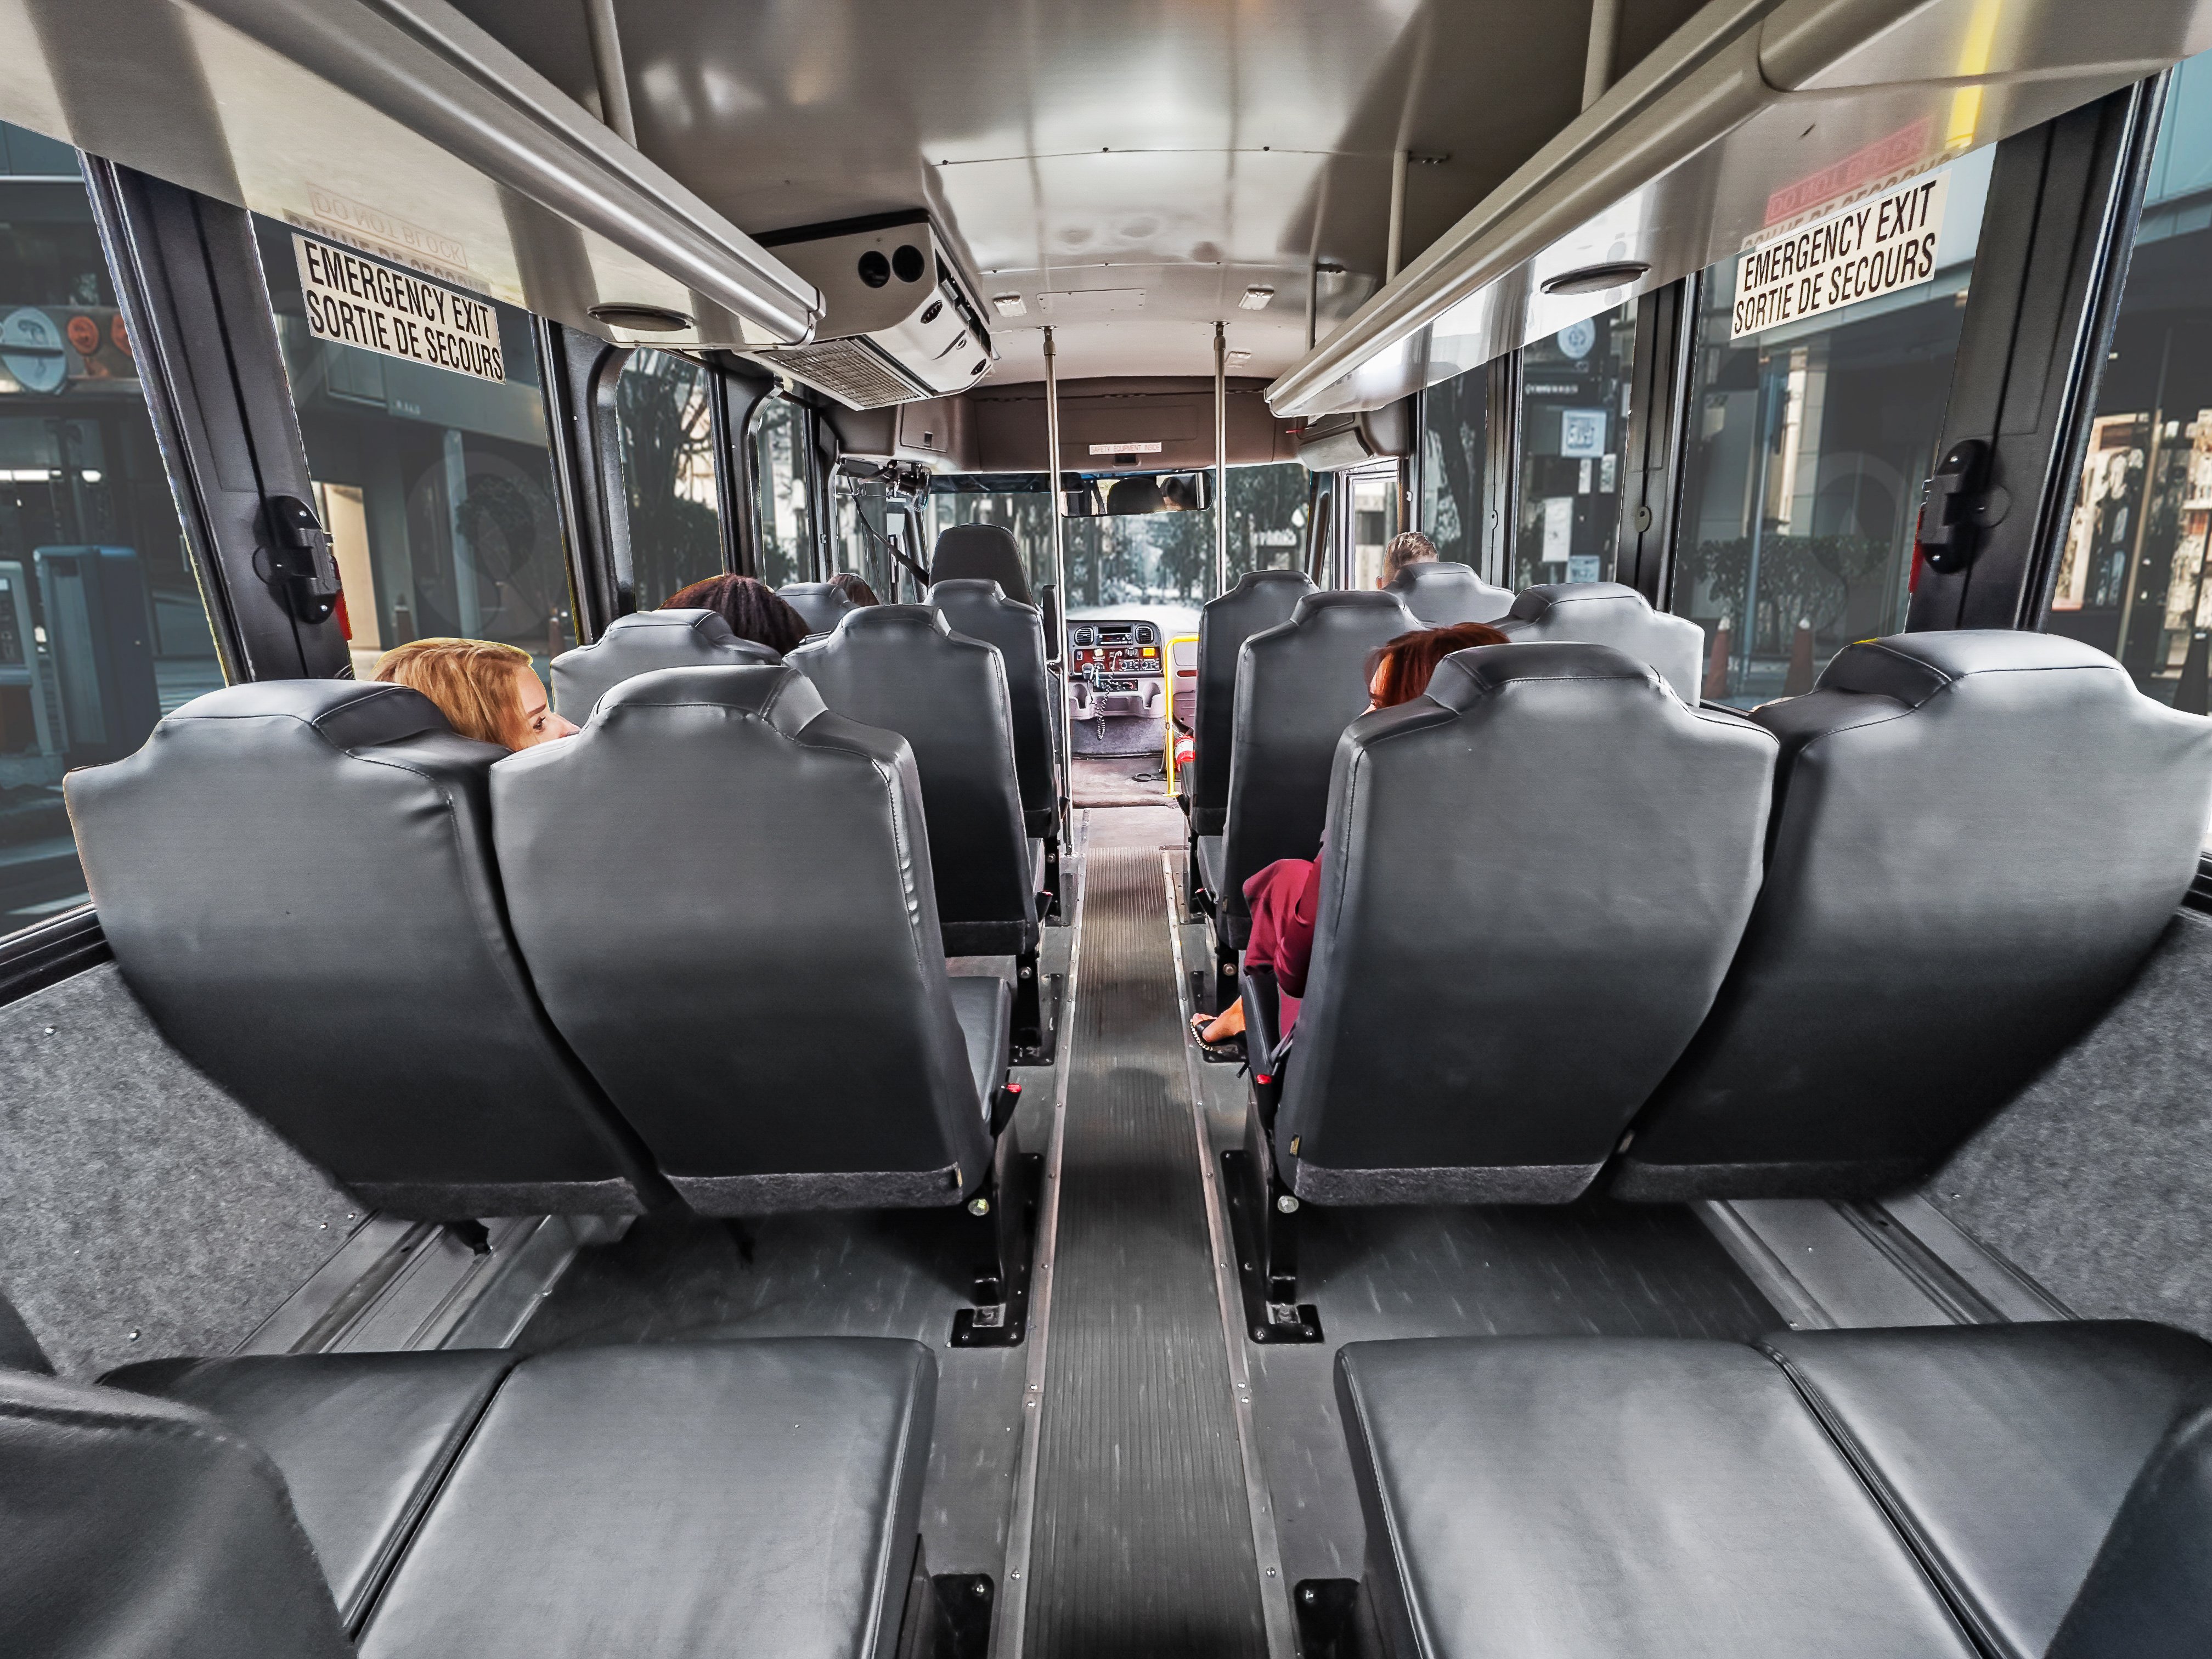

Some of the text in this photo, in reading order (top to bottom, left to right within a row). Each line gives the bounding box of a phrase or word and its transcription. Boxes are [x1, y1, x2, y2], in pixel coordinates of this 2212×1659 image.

[1734, 282, 1794, 334] SORTIE
[1797, 272, 1824, 314] DE
[1828, 232, 1936, 305] SECOURS
[1743, 207, 1872, 292] EMERGENCY
[1876, 179, 1937, 244] EXIT
[304, 240, 445, 325] EMERGENCY
[451, 295, 490, 339] EXIT
[306, 289, 503, 380] SORTIE DE SECOURS
